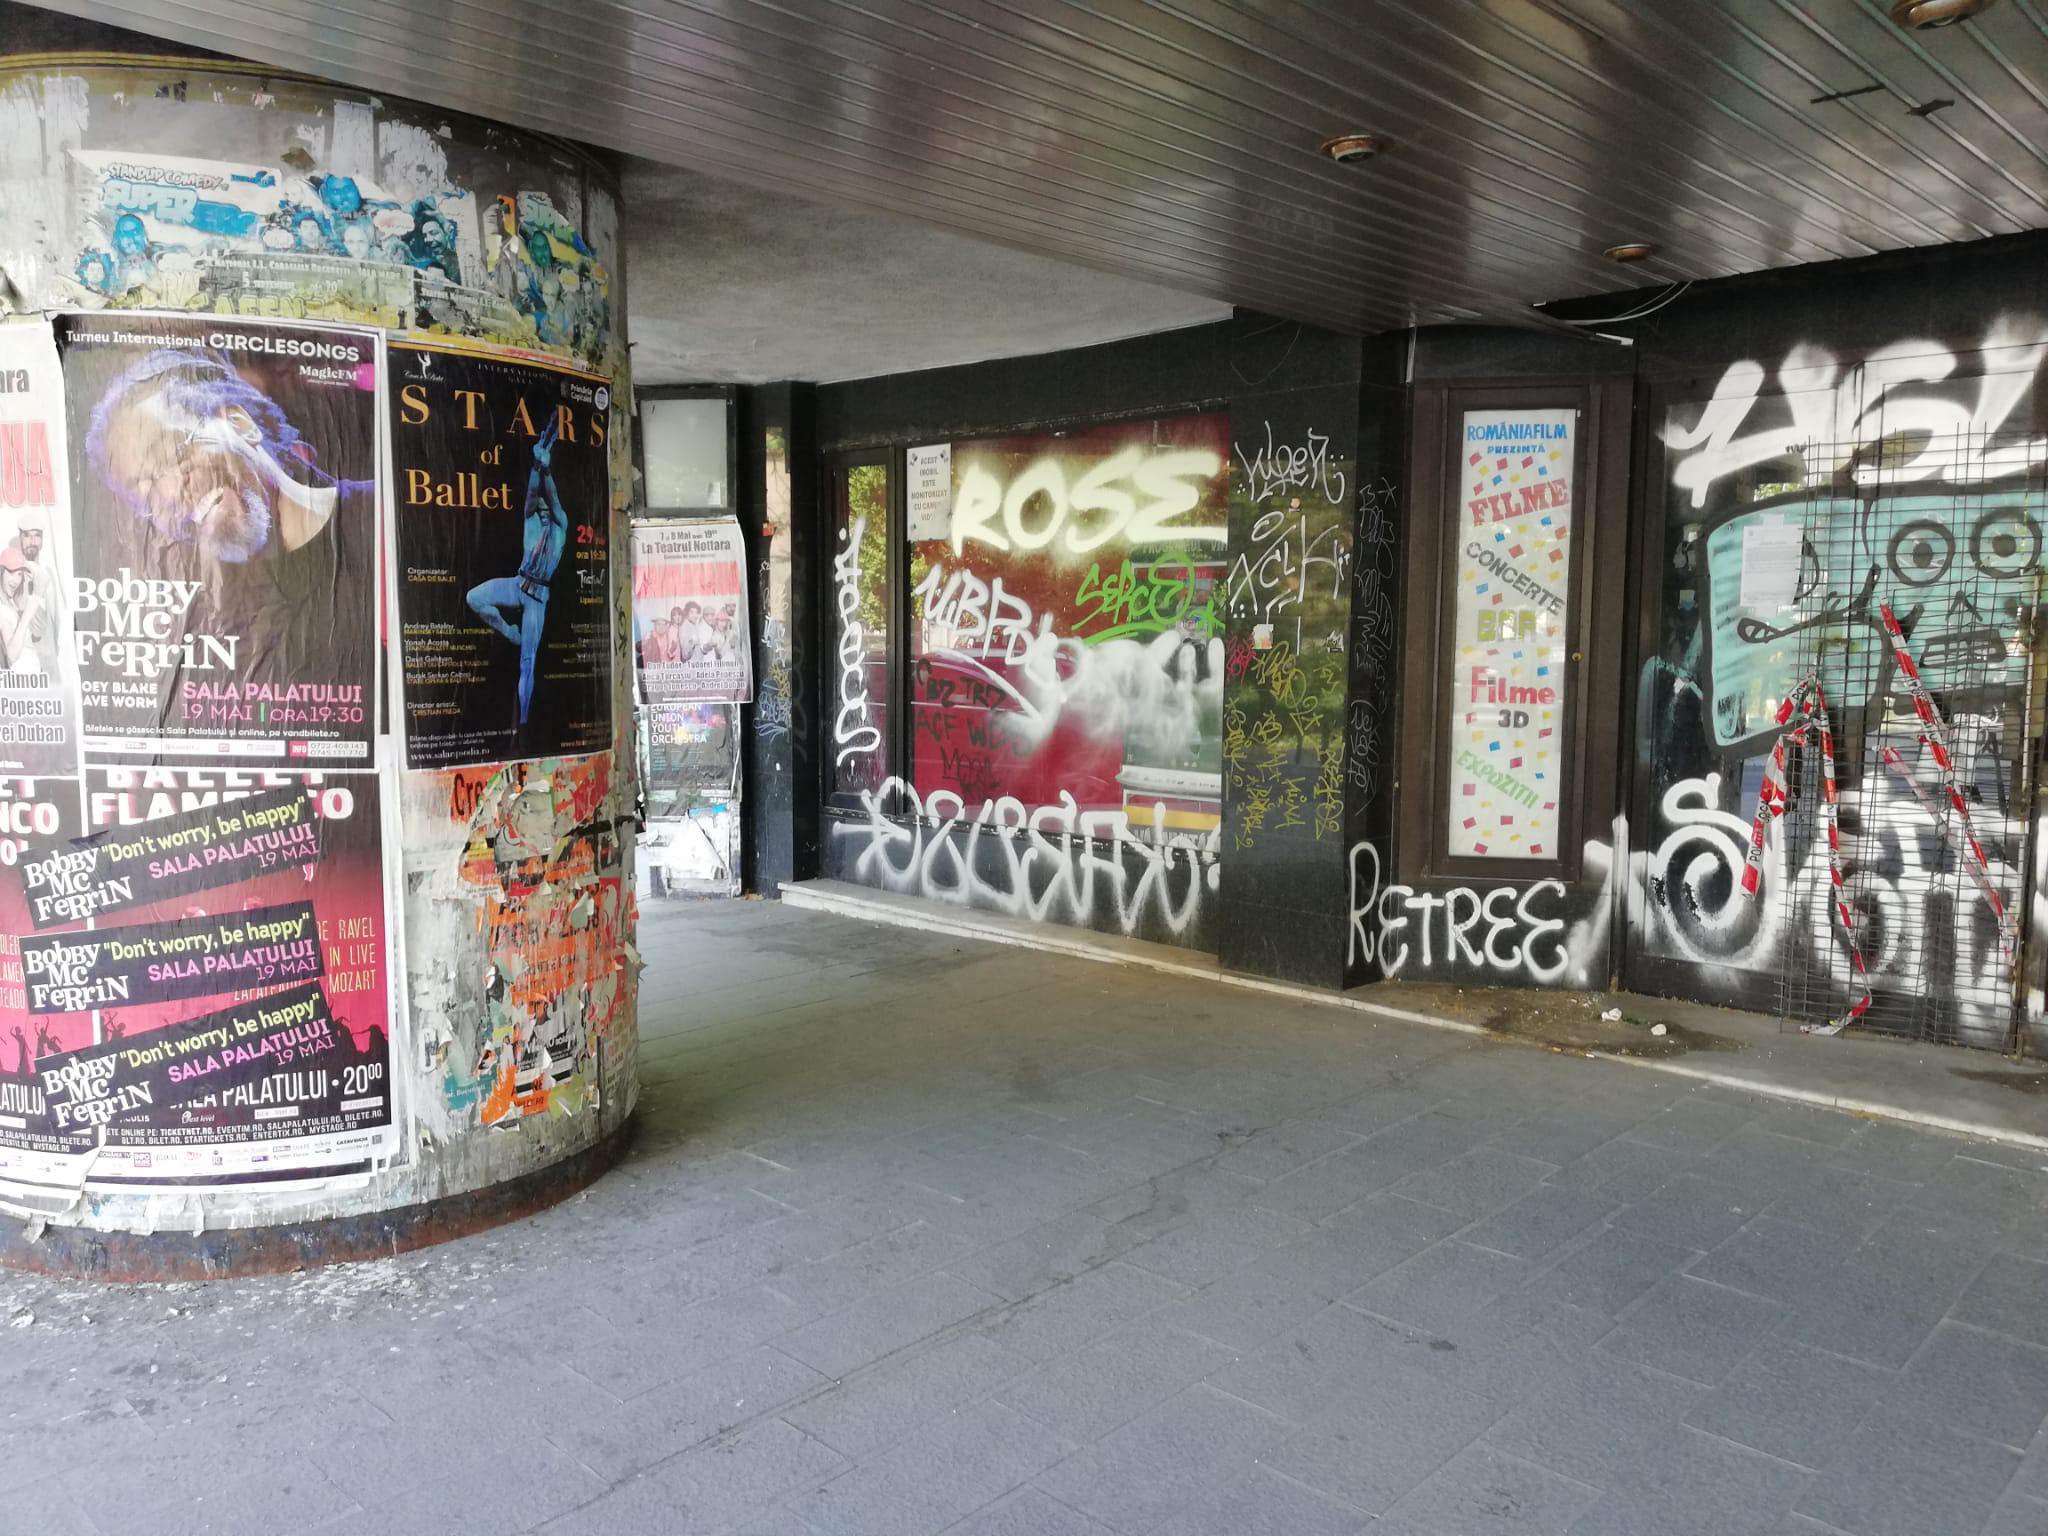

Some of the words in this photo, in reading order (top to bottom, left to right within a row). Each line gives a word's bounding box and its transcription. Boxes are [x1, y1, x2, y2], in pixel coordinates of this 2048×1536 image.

[65, 330, 109, 343] Turneu
[112, 331, 206, 348] Internațional
[209, 333, 360, 362] CIRCLESONGS
[481, 444, 503, 466] of
[406, 468, 514, 511] Ballet
[911, 489, 948, 499] MONITORIZAT
[922, 479, 936, 487] ESTE
[951, 449, 1227, 560] ROSE
[1468, 478, 1569, 527] FILME
[576, 524, 594, 545] 29
[642, 543, 653, 553] La
[654, 541, 691, 553] Teatrul
[694, 540, 731, 551] Nottara
[1466, 541, 1566, 616] CONCERTE
[112, 682, 158, 694] BLAKE
[183, 681, 238, 701] SALA
[245, 683, 362, 704] PALATULUI
[1471, 666, 1556, 704] Filme
[2, 698, 62, 716] Popescu
[112, 697, 158, 709] WORM
[182, 704, 203, 719] 19
[210, 704, 253, 721] MAI
[651, 712, 684, 722] UNION
[1498, 709, 1529, 728] 3D
[18, 724, 64, 742] Duban
[188, 728, 227, 736] Palatului
[651, 734, 708, 746] ORCHESTRA
[292, 744, 307, 754] INFO
[156, 823, 217, 850] worry,
[217, 814, 242, 834] be
[243, 796, 305, 829] happy"
[150, 856, 202, 880] SALA
[205, 823, 315, 866] PALATULUI
[258, 852, 277, 869] 19
[282, 840, 320, 862] MAI
[161, 931, 218, 956] worry,
[219, 925, 243, 944] be
[246, 912, 310, 944] happy"
[338, 917, 376, 940] RAVEL
[149, 962, 200, 982] SALA
[204, 938, 314, 973] PALATULUI
[329, 948, 341, 966] IN
[349, 944, 376, 963] LIVE
[256, 964, 277, 981] 19
[281, 956, 319, 976] MAI
[328, 970, 376, 995] MOZART
[175, 1026, 235, 1056] worry,
[234, 1017, 258, 1037] be
[260, 994, 321, 1030] happy"
[168, 1060, 222, 1084] SALA
[224, 1018, 331, 1066] PALATULUI
[276, 1050, 295, 1067] 19
[300, 1036, 336, 1060] MAI
[221, 1069, 328, 1108] PALATULUI
[121, 1128, 145, 1137] ONLINE
